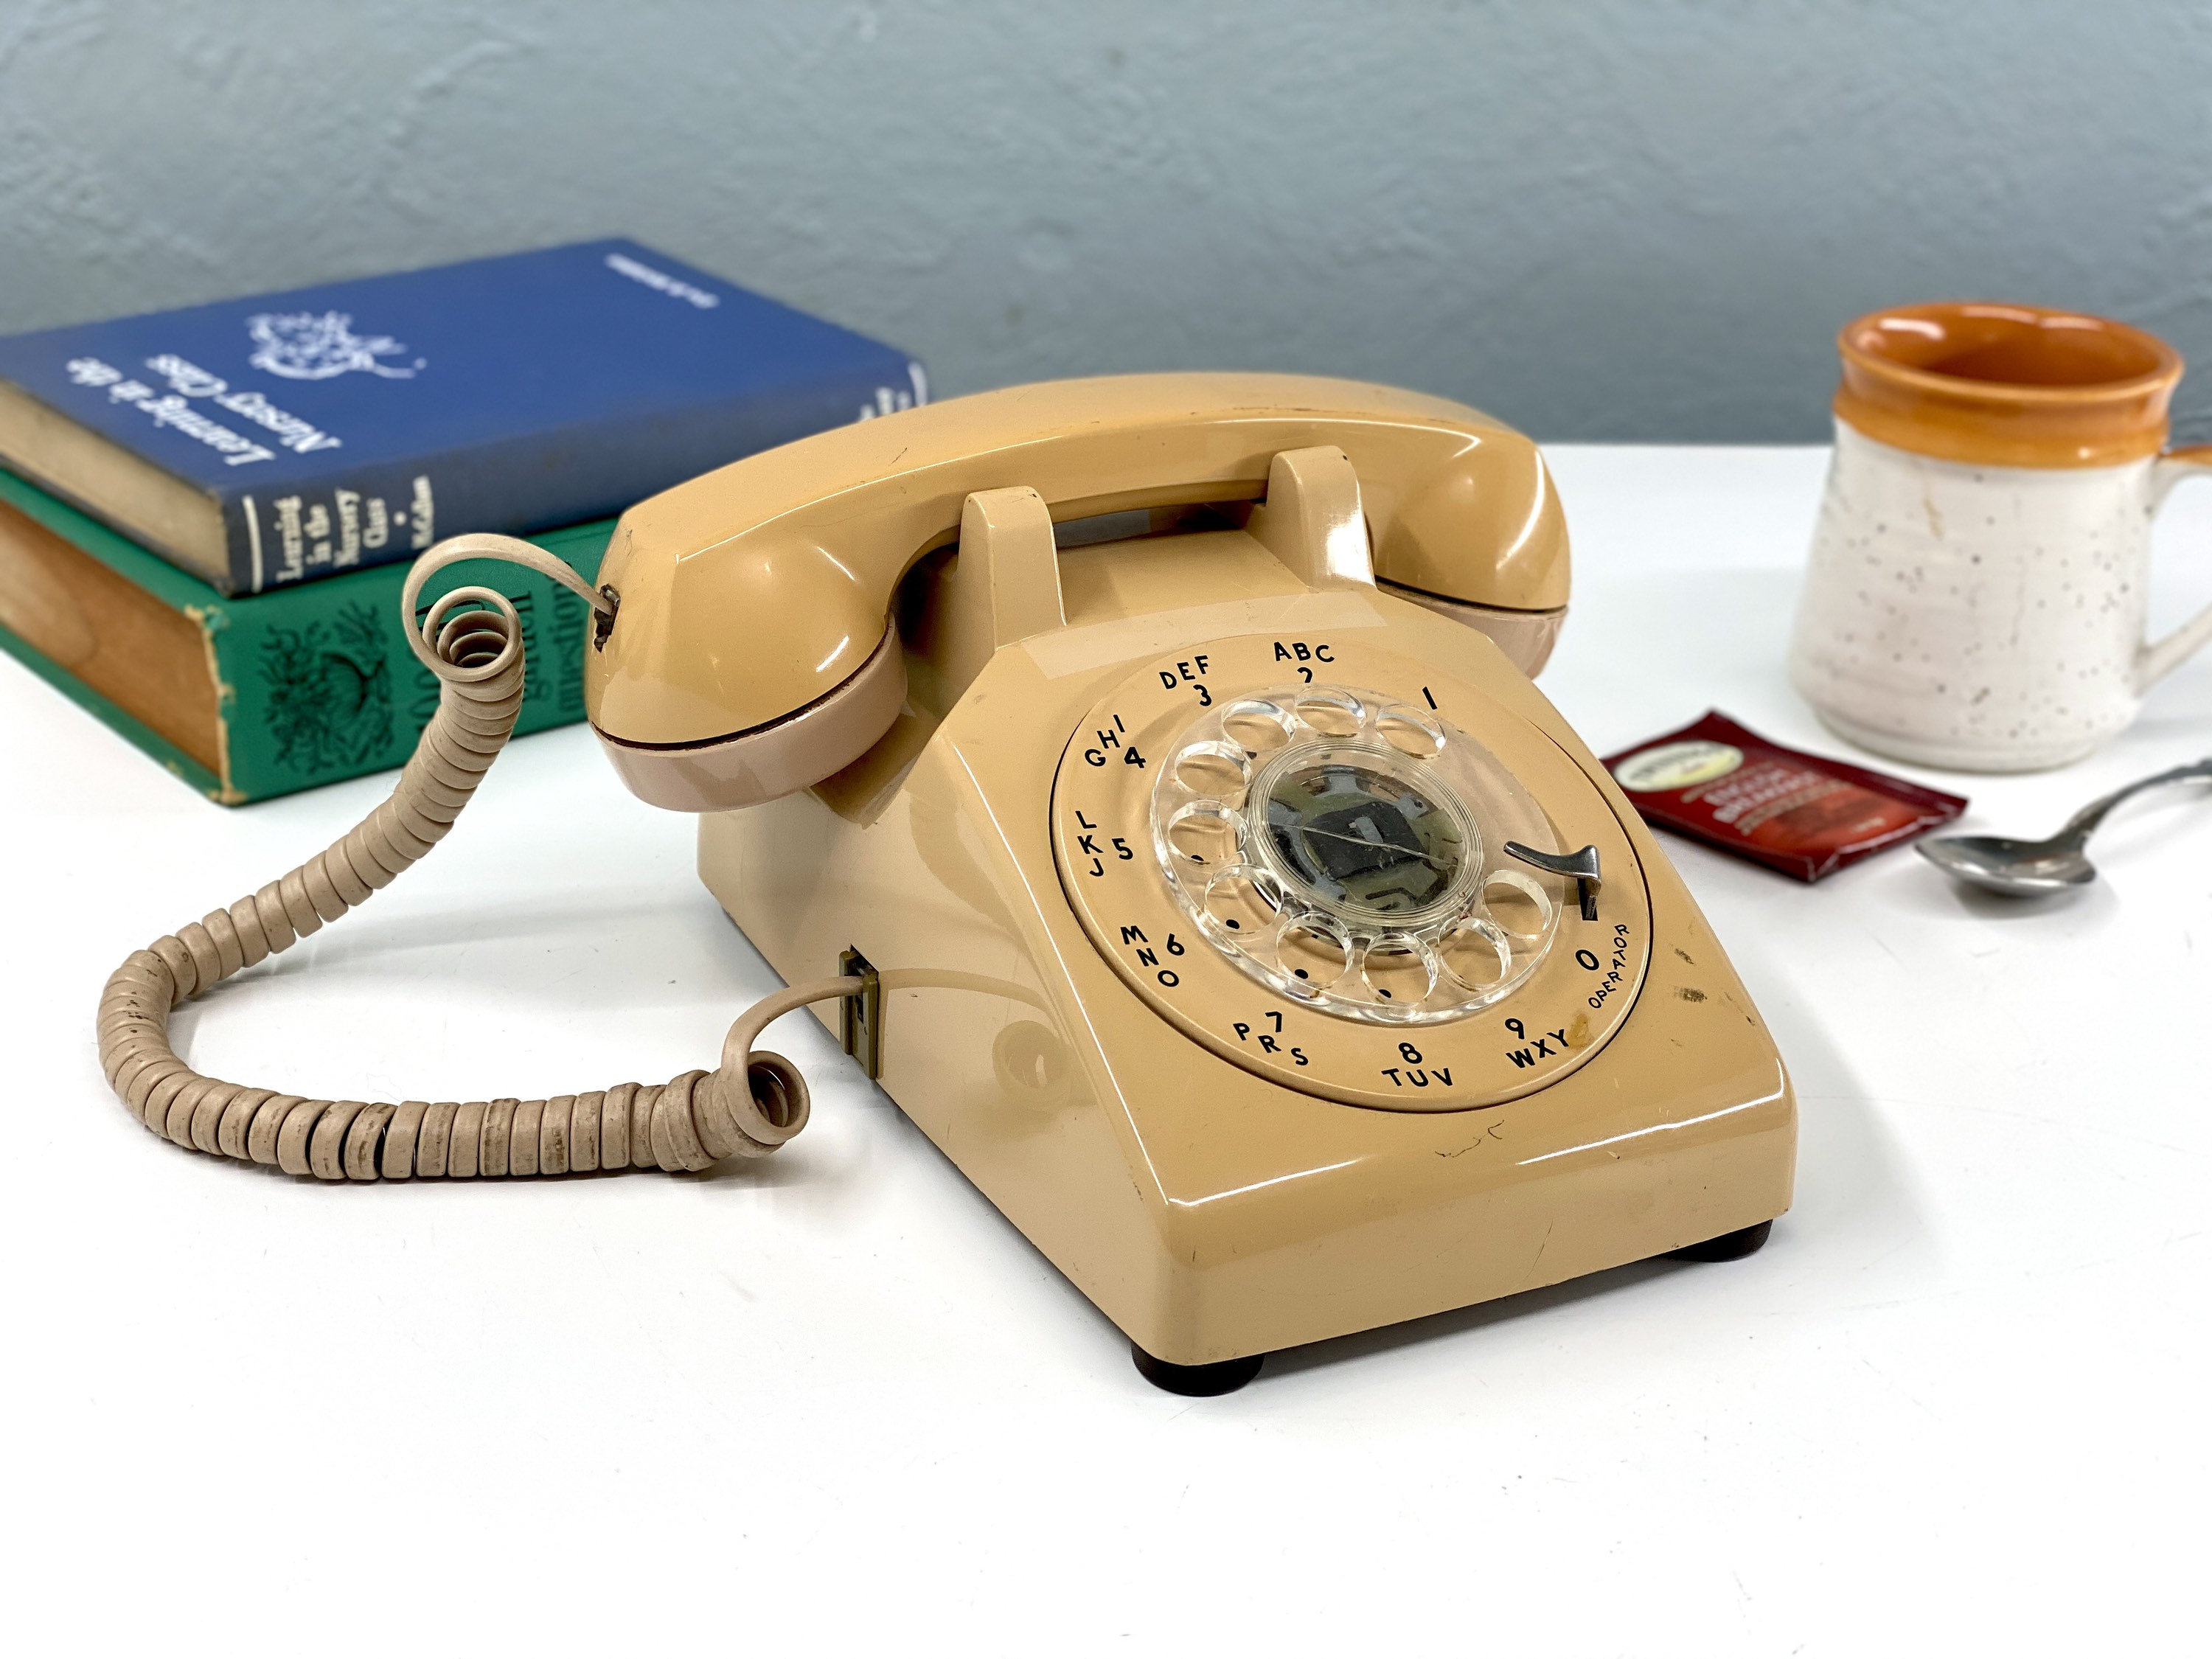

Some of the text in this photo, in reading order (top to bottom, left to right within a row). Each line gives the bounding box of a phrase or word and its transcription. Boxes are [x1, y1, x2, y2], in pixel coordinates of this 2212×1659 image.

[66, 356, 276, 465] Learning in the
[213, 392, 341, 453] Nursery
[304, 504, 331, 565] in the
[333, 487, 361, 568] Nursery
[363, 497, 388, 549] Class
[274, 495, 303, 583] Learning
[1273, 641, 1335, 663] ABC
[1159, 655, 1210, 689] DEF
[1193, 684, 1212, 706] 3
[1124, 746, 1147, 768] 4
[1112, 838, 1134, 860] 5
[1166, 933, 1186, 956] 6
[1587, 924, 1630, 1009] OPERATOR
[1265, 1011, 1283, 1033] 7
[1504, 1018, 1525, 1040] 9
[1398, 1042, 1423, 1064] 8
[1505, 1029, 1570, 1068] WXY
[1381, 1067, 1453, 1088] TUV
